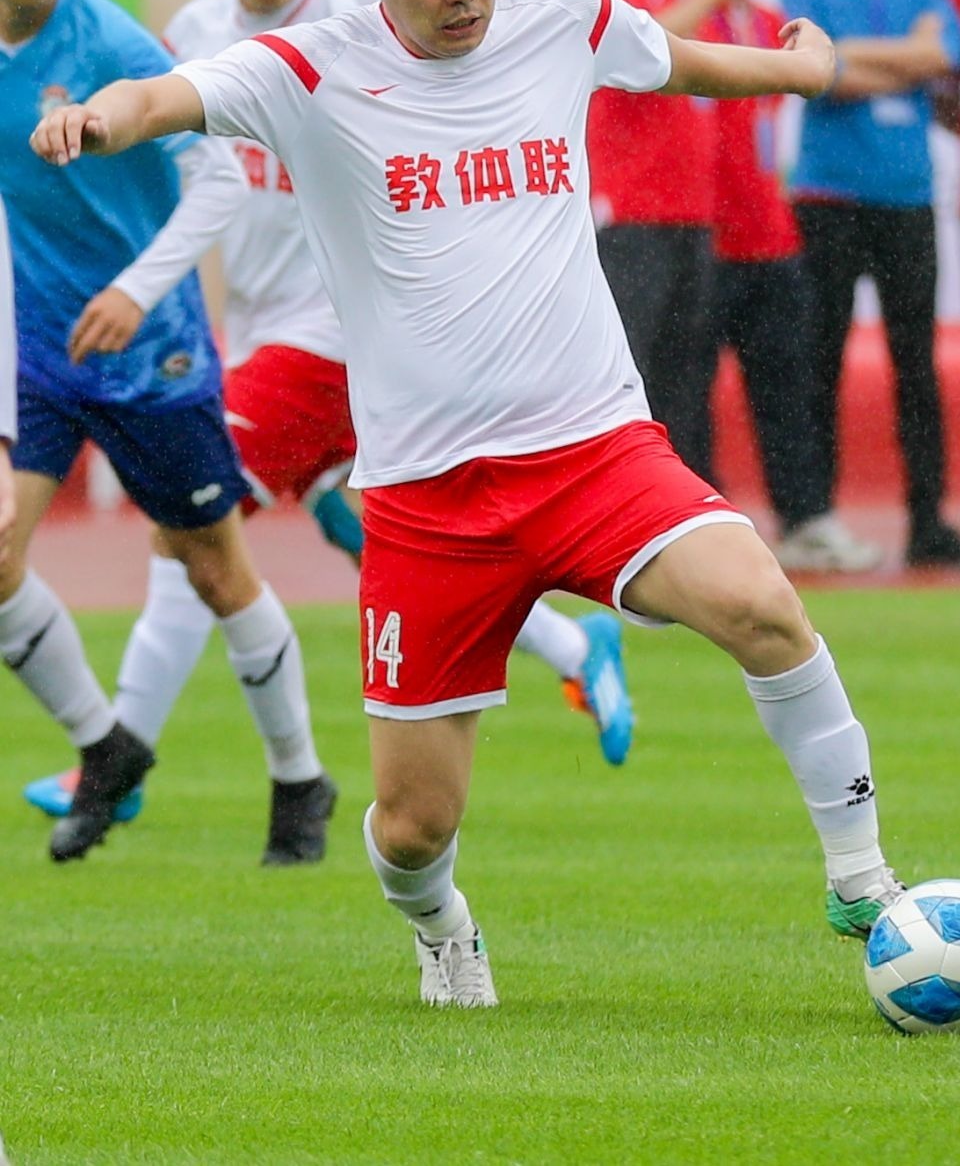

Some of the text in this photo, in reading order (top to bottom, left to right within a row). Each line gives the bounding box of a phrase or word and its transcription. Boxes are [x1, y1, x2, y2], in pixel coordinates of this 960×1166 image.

[385, 137, 574, 213] 教体联
[365, 607, 403, 688] 14
